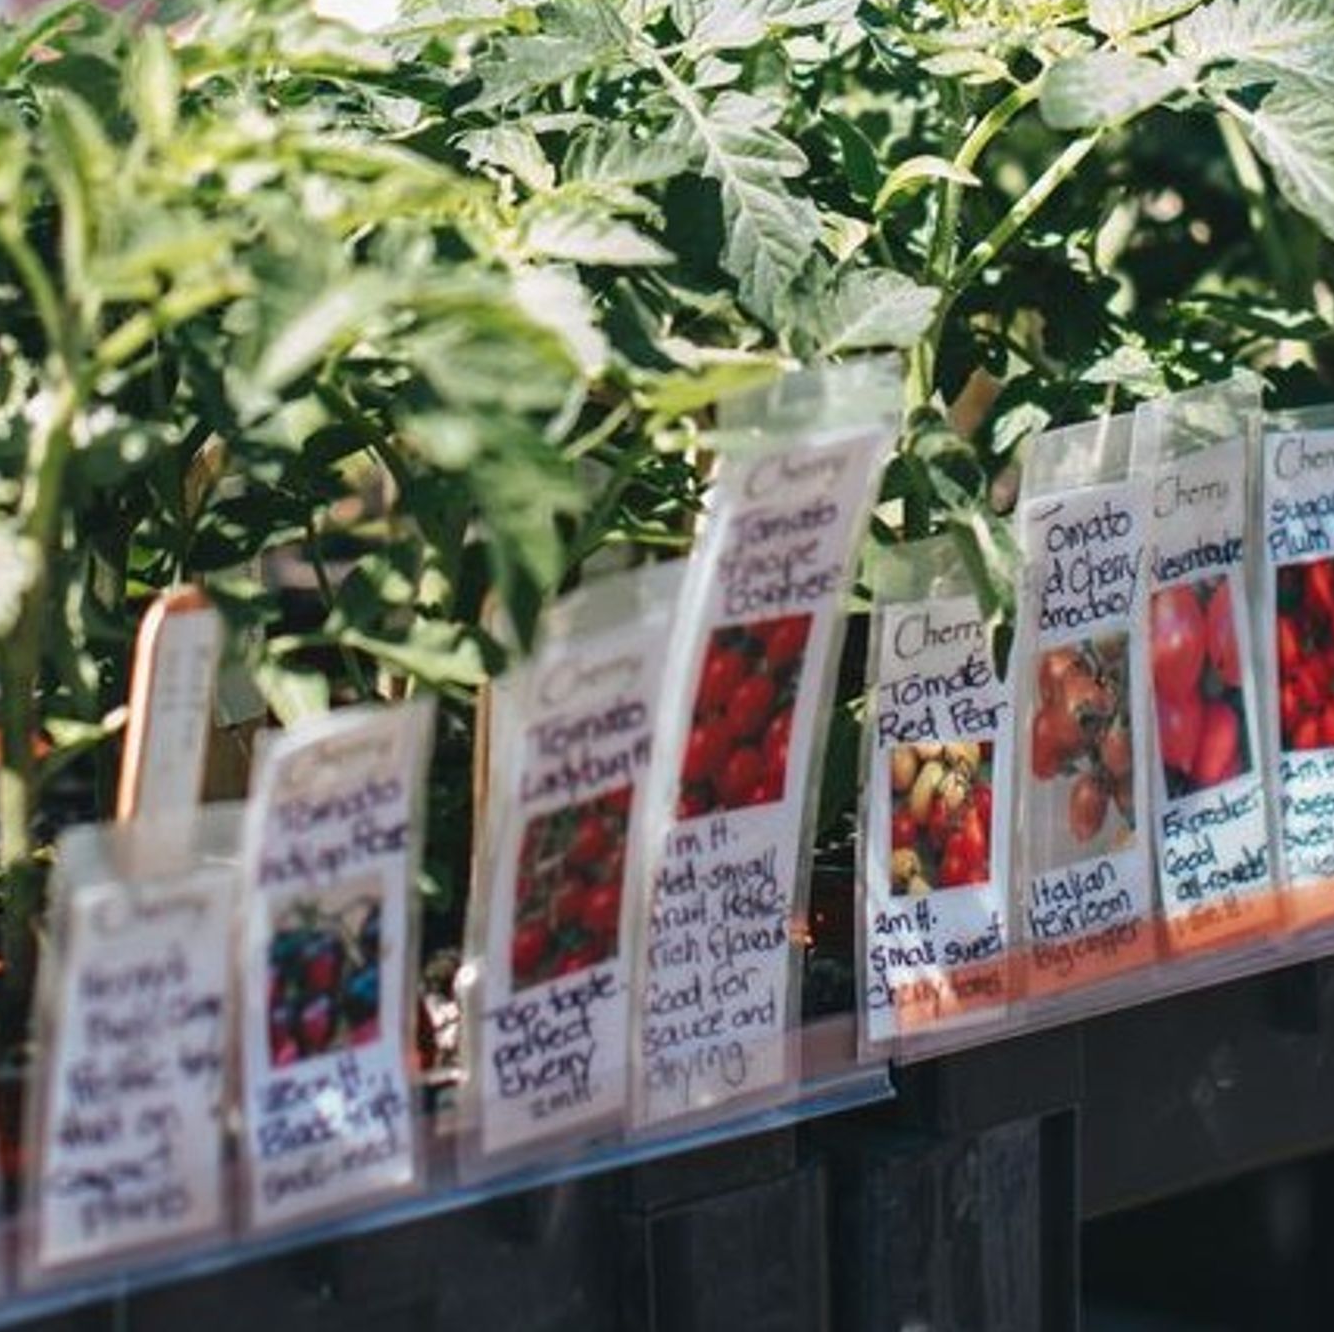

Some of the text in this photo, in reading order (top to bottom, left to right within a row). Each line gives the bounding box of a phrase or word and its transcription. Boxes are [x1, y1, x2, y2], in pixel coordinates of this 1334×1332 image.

[1154, 474, 1230, 518] Cherry
[733, 500, 838, 544] Tomato
[1068, 546, 1144, 614] Cherry
[894, 612, 986, 659] Cherry
[879, 654, 992, 706] Tomato
[878, 698, 1010, 749] Red Pear
[1031, 859, 1117, 907] Italian
[1028, 889, 1133, 938] heirloom
[709, 968, 760, 1005] for
[641, 983, 775, 1057] sauce and
